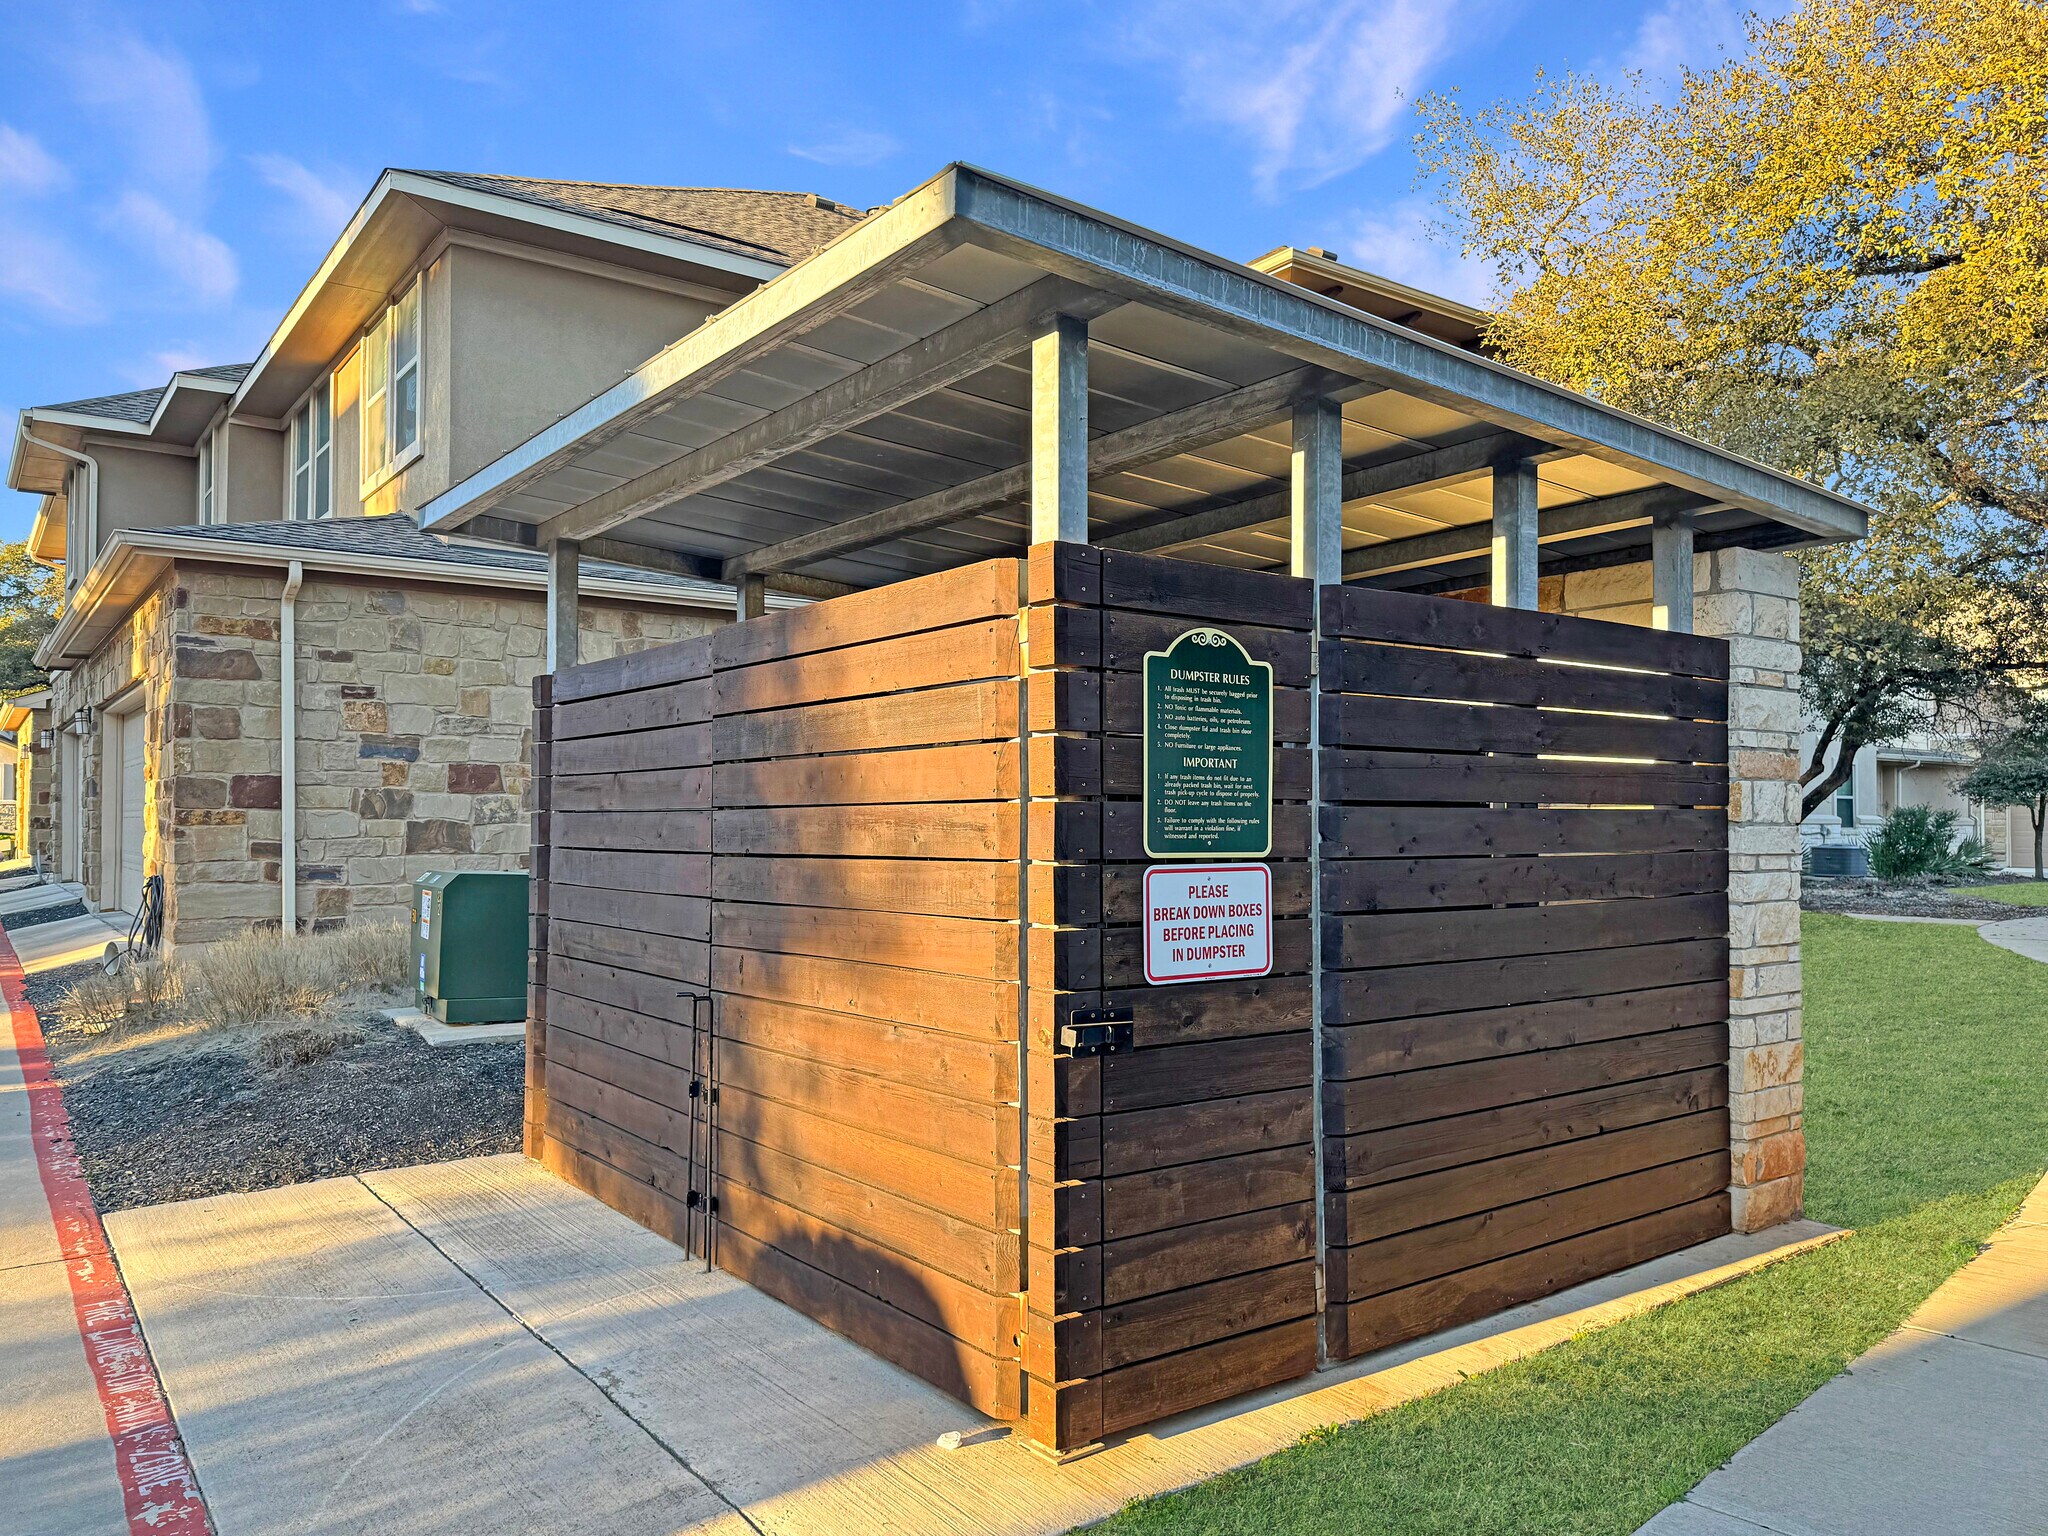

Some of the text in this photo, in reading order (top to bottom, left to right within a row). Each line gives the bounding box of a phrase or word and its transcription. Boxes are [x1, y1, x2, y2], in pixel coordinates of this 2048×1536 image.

[1170, 669, 1250, 686] DUMPSTER RULES
[1170, 694, 1193, 703] disposing
[1208, 690, 1228, 698] securely
[1228, 690, 1245, 699] bagged
[1194, 705, 1219, 713] flammable
[1186, 715, 1208, 723] batteries,
[1209, 716, 1219, 724] oils,
[1178, 724, 1201, 732] dumpster
[1164, 732, 1191, 740] completely.
[1204, 743, 1216, 752] large
[1217, 744, 1243, 752] appliances.
[1183, 756, 1238, 769] IMPORTANT
[1164, 781, 1181, 789] already
[1213, 782, 1223, 790] bin,
[1177, 789, 1195, 797] pick-up
[1215, 790, 1233, 798] dispose
[1239, 790, 1260, 799] properly.
[1187, 817, 1205, 825] comply
[1226, 817, 1248, 825] following
[1225, 824, 1236, 832] fine,
[1198, 833, 1219, 841] reported.
[1188, 884, 1229, 899] PLEASE
[1153, 903, 1263, 921] BREAK DOWN BOXES
[1163, 923, 1254, 942] BEFORE PLACING
[1172, 944, 1246, 962] IN DUMPSTER
[82, 1299, 132, 1327] FIRE
[87, 1327, 142, 1364] LANE
[129, 1449, 191, 1497] ZONE
